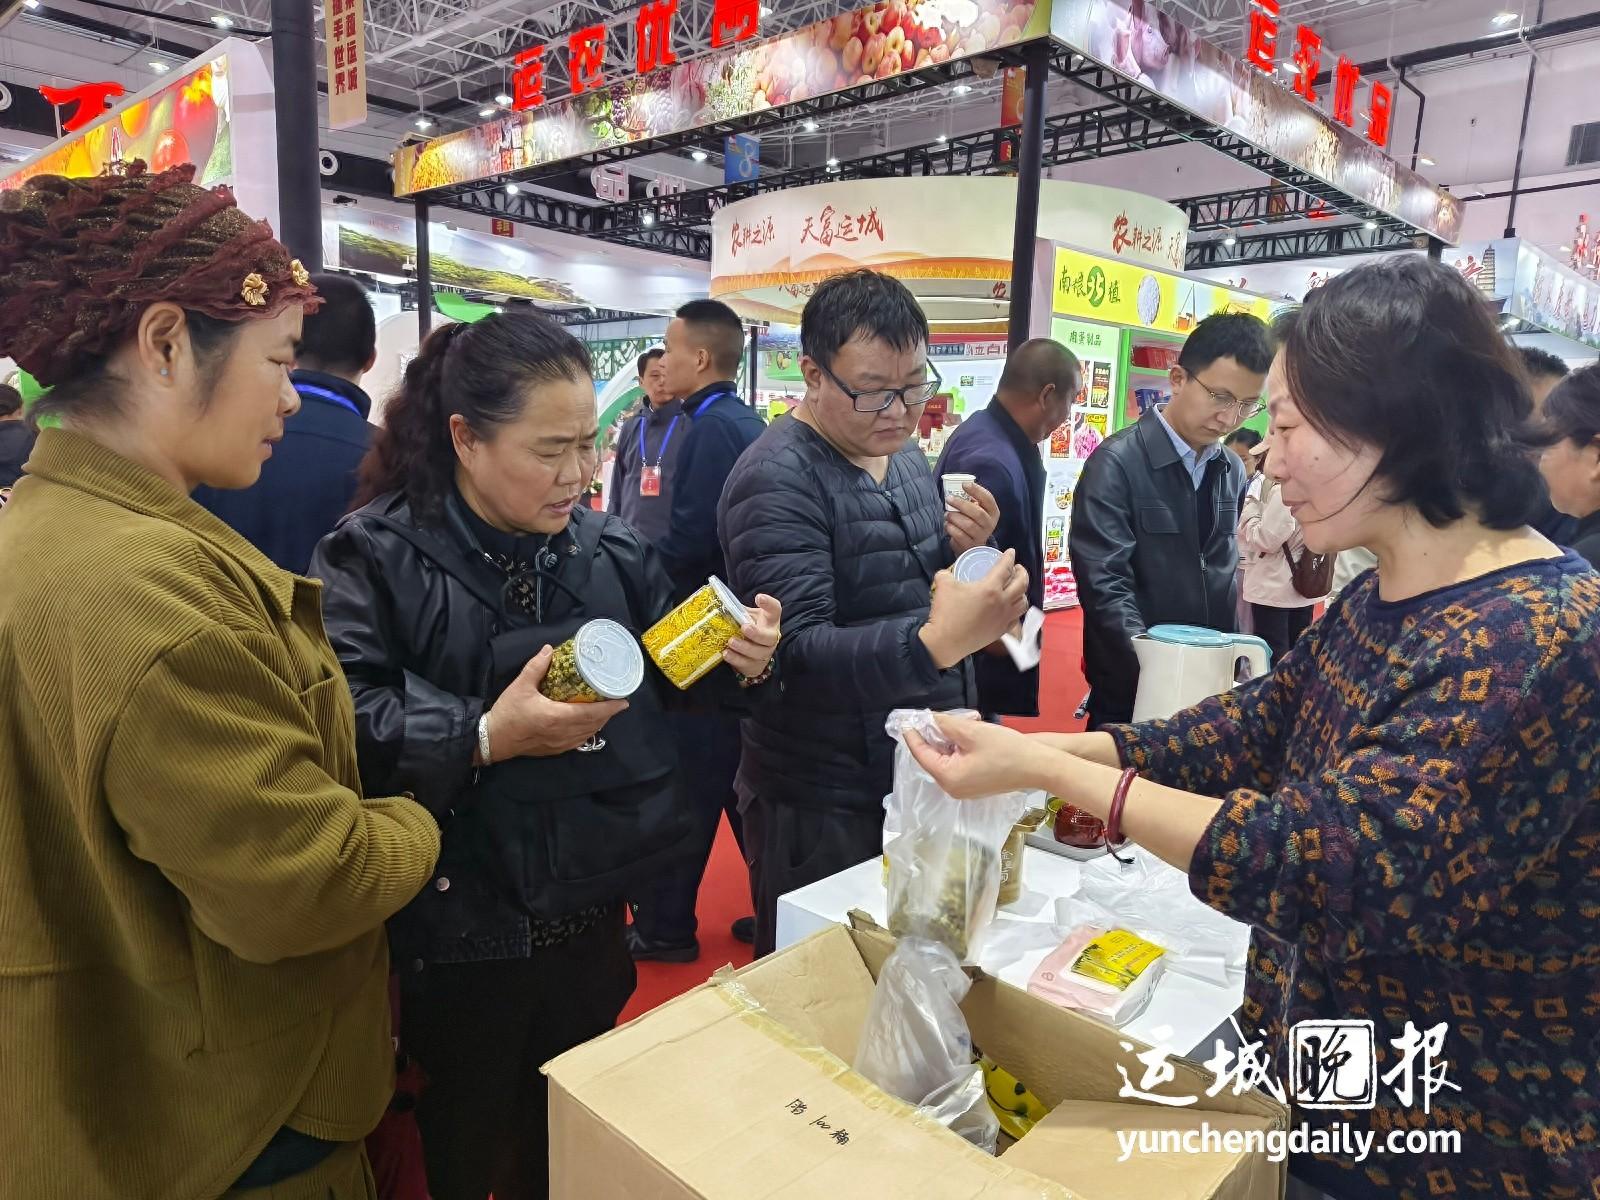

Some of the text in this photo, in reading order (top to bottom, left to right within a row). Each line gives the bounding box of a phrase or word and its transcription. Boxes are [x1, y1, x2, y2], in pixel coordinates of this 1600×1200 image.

[731, 205, 884, 257] 农耕之源 天富运城
[1112, 209, 1163, 255] 农耕之源
